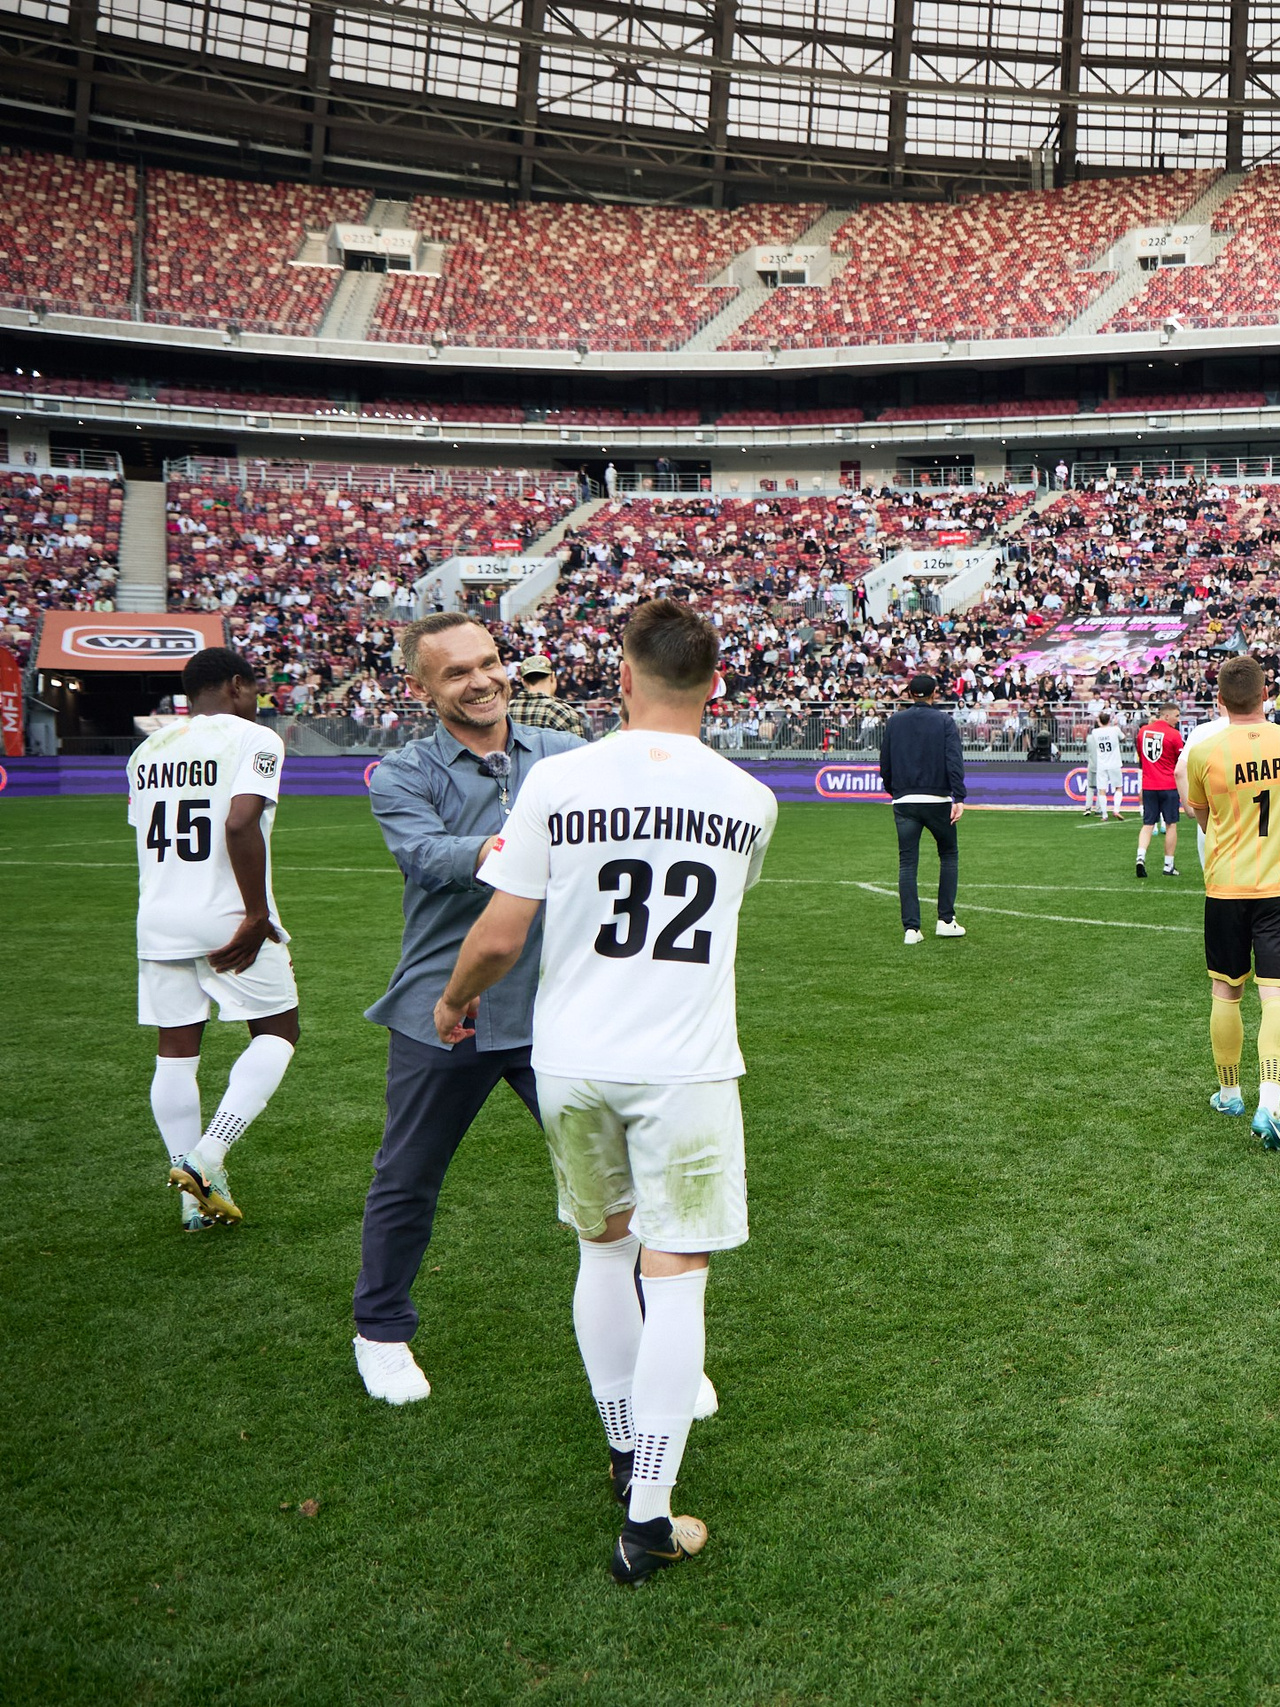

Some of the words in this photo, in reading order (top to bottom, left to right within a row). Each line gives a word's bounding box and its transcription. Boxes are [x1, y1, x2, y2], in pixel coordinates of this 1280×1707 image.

[1148, 237, 1167, 246] 228
[769, 255, 787, 263] 230
[923, 559, 945, 569] 126
[965, 557, 984, 568] 12
[522, 564, 542, 574] 12
[97, 636, 193, 649] Win
[1099, 741, 1112, 752] 93
[137, 760, 218, 790] SANOGO
[1252, 790, 1270, 837] 1
[147, 799, 212, 862] 45
[548, 806, 762, 855] DOROZHINSKIY
[594, 858, 717, 964] 32
